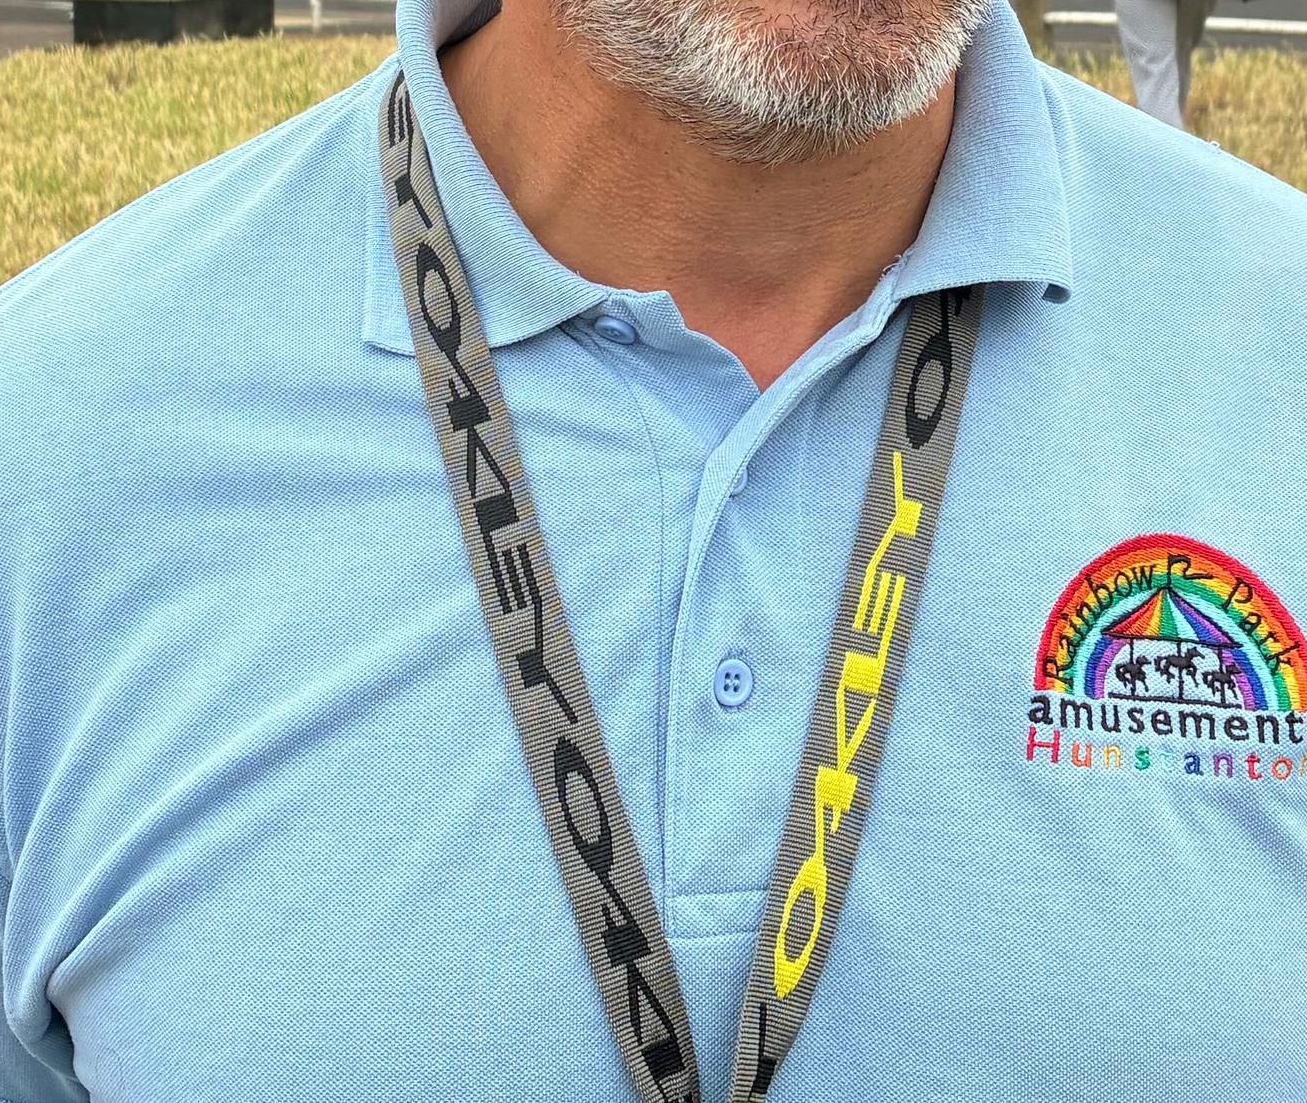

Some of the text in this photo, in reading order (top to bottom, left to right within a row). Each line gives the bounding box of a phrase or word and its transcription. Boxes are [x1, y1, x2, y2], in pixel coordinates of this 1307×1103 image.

[416, 243, 578, 724] OAKLEY
[1043, 563, 1156, 689] Rainbow
[1223, 577, 1300, 675] Park
[774, 452, 922, 999] OAKLEY
[553, 735, 697, 1103] OAKL
